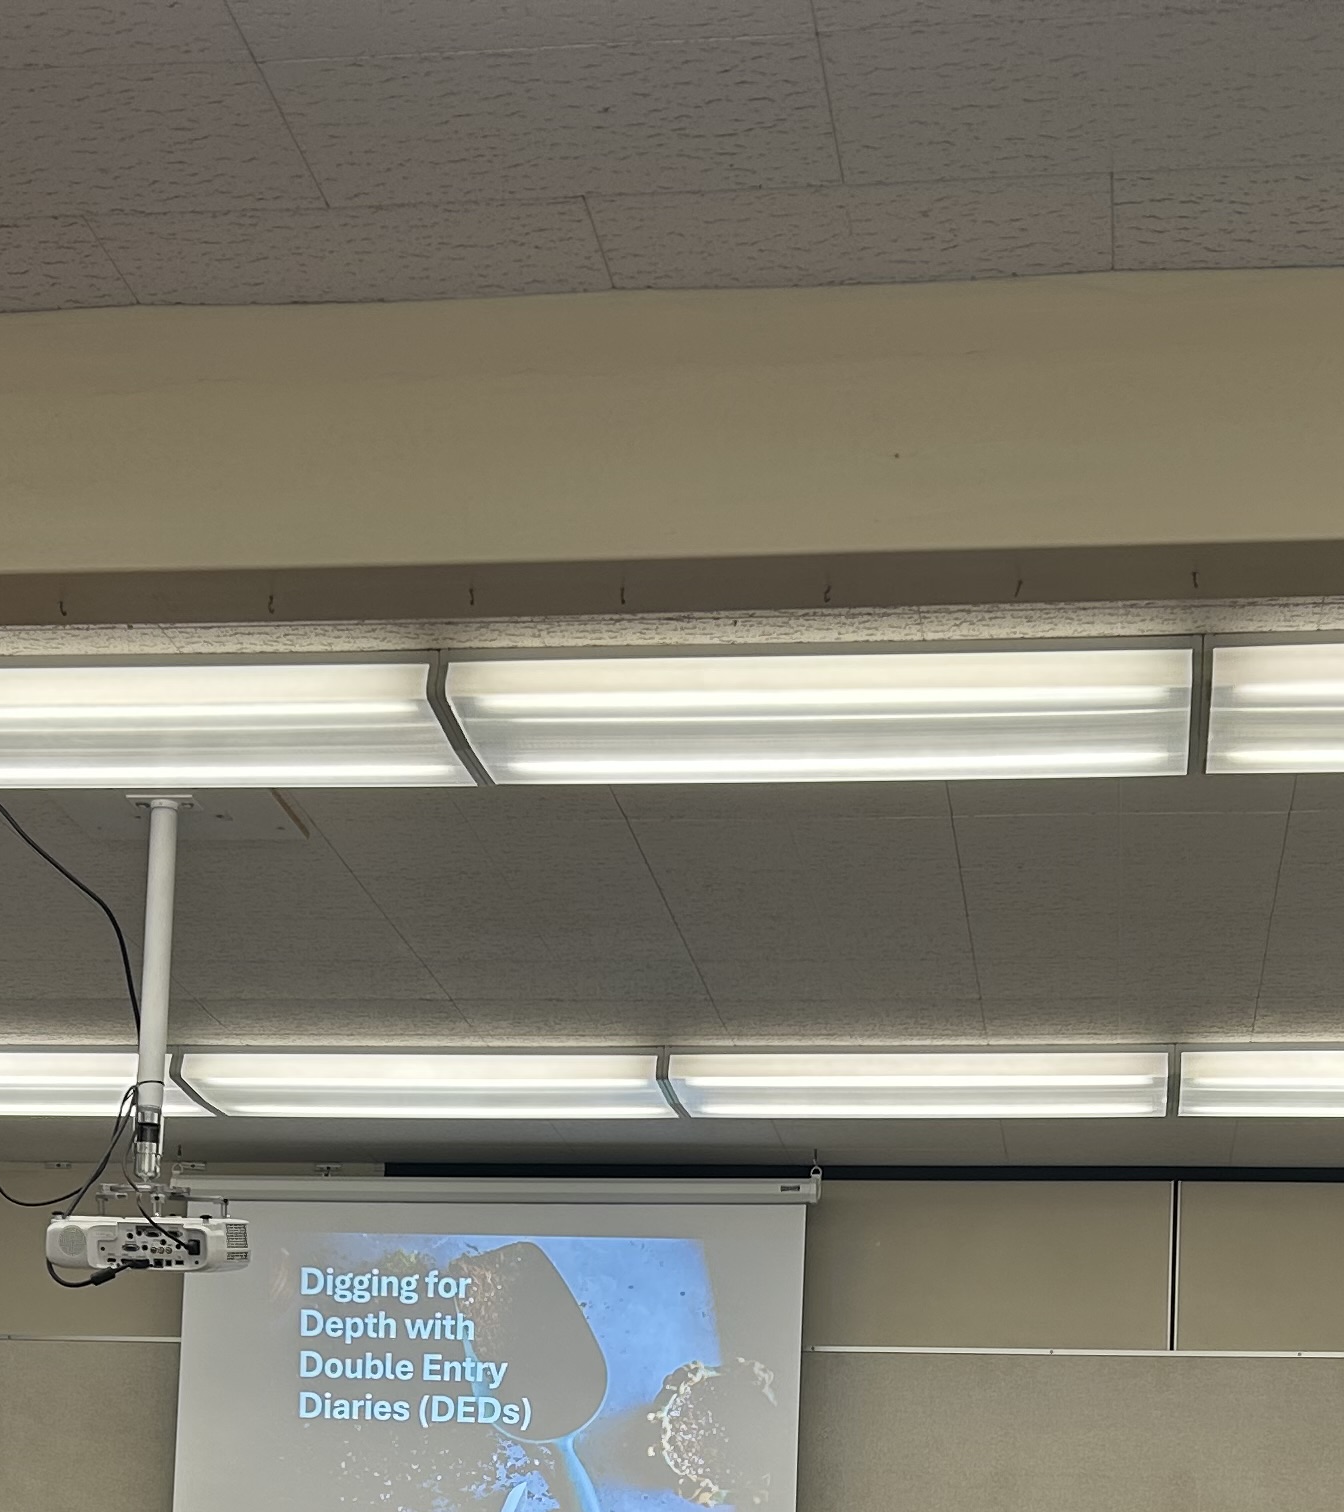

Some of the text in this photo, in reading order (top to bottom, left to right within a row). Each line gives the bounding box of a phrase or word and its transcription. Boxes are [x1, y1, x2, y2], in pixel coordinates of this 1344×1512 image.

[300, 1267, 472, 1304] Digging for
[299, 1308, 475, 1344] Depth with
[299, 1350, 509, 1389] Double Entry
[298, 1391, 532, 1431] Diaries (DEDs)
